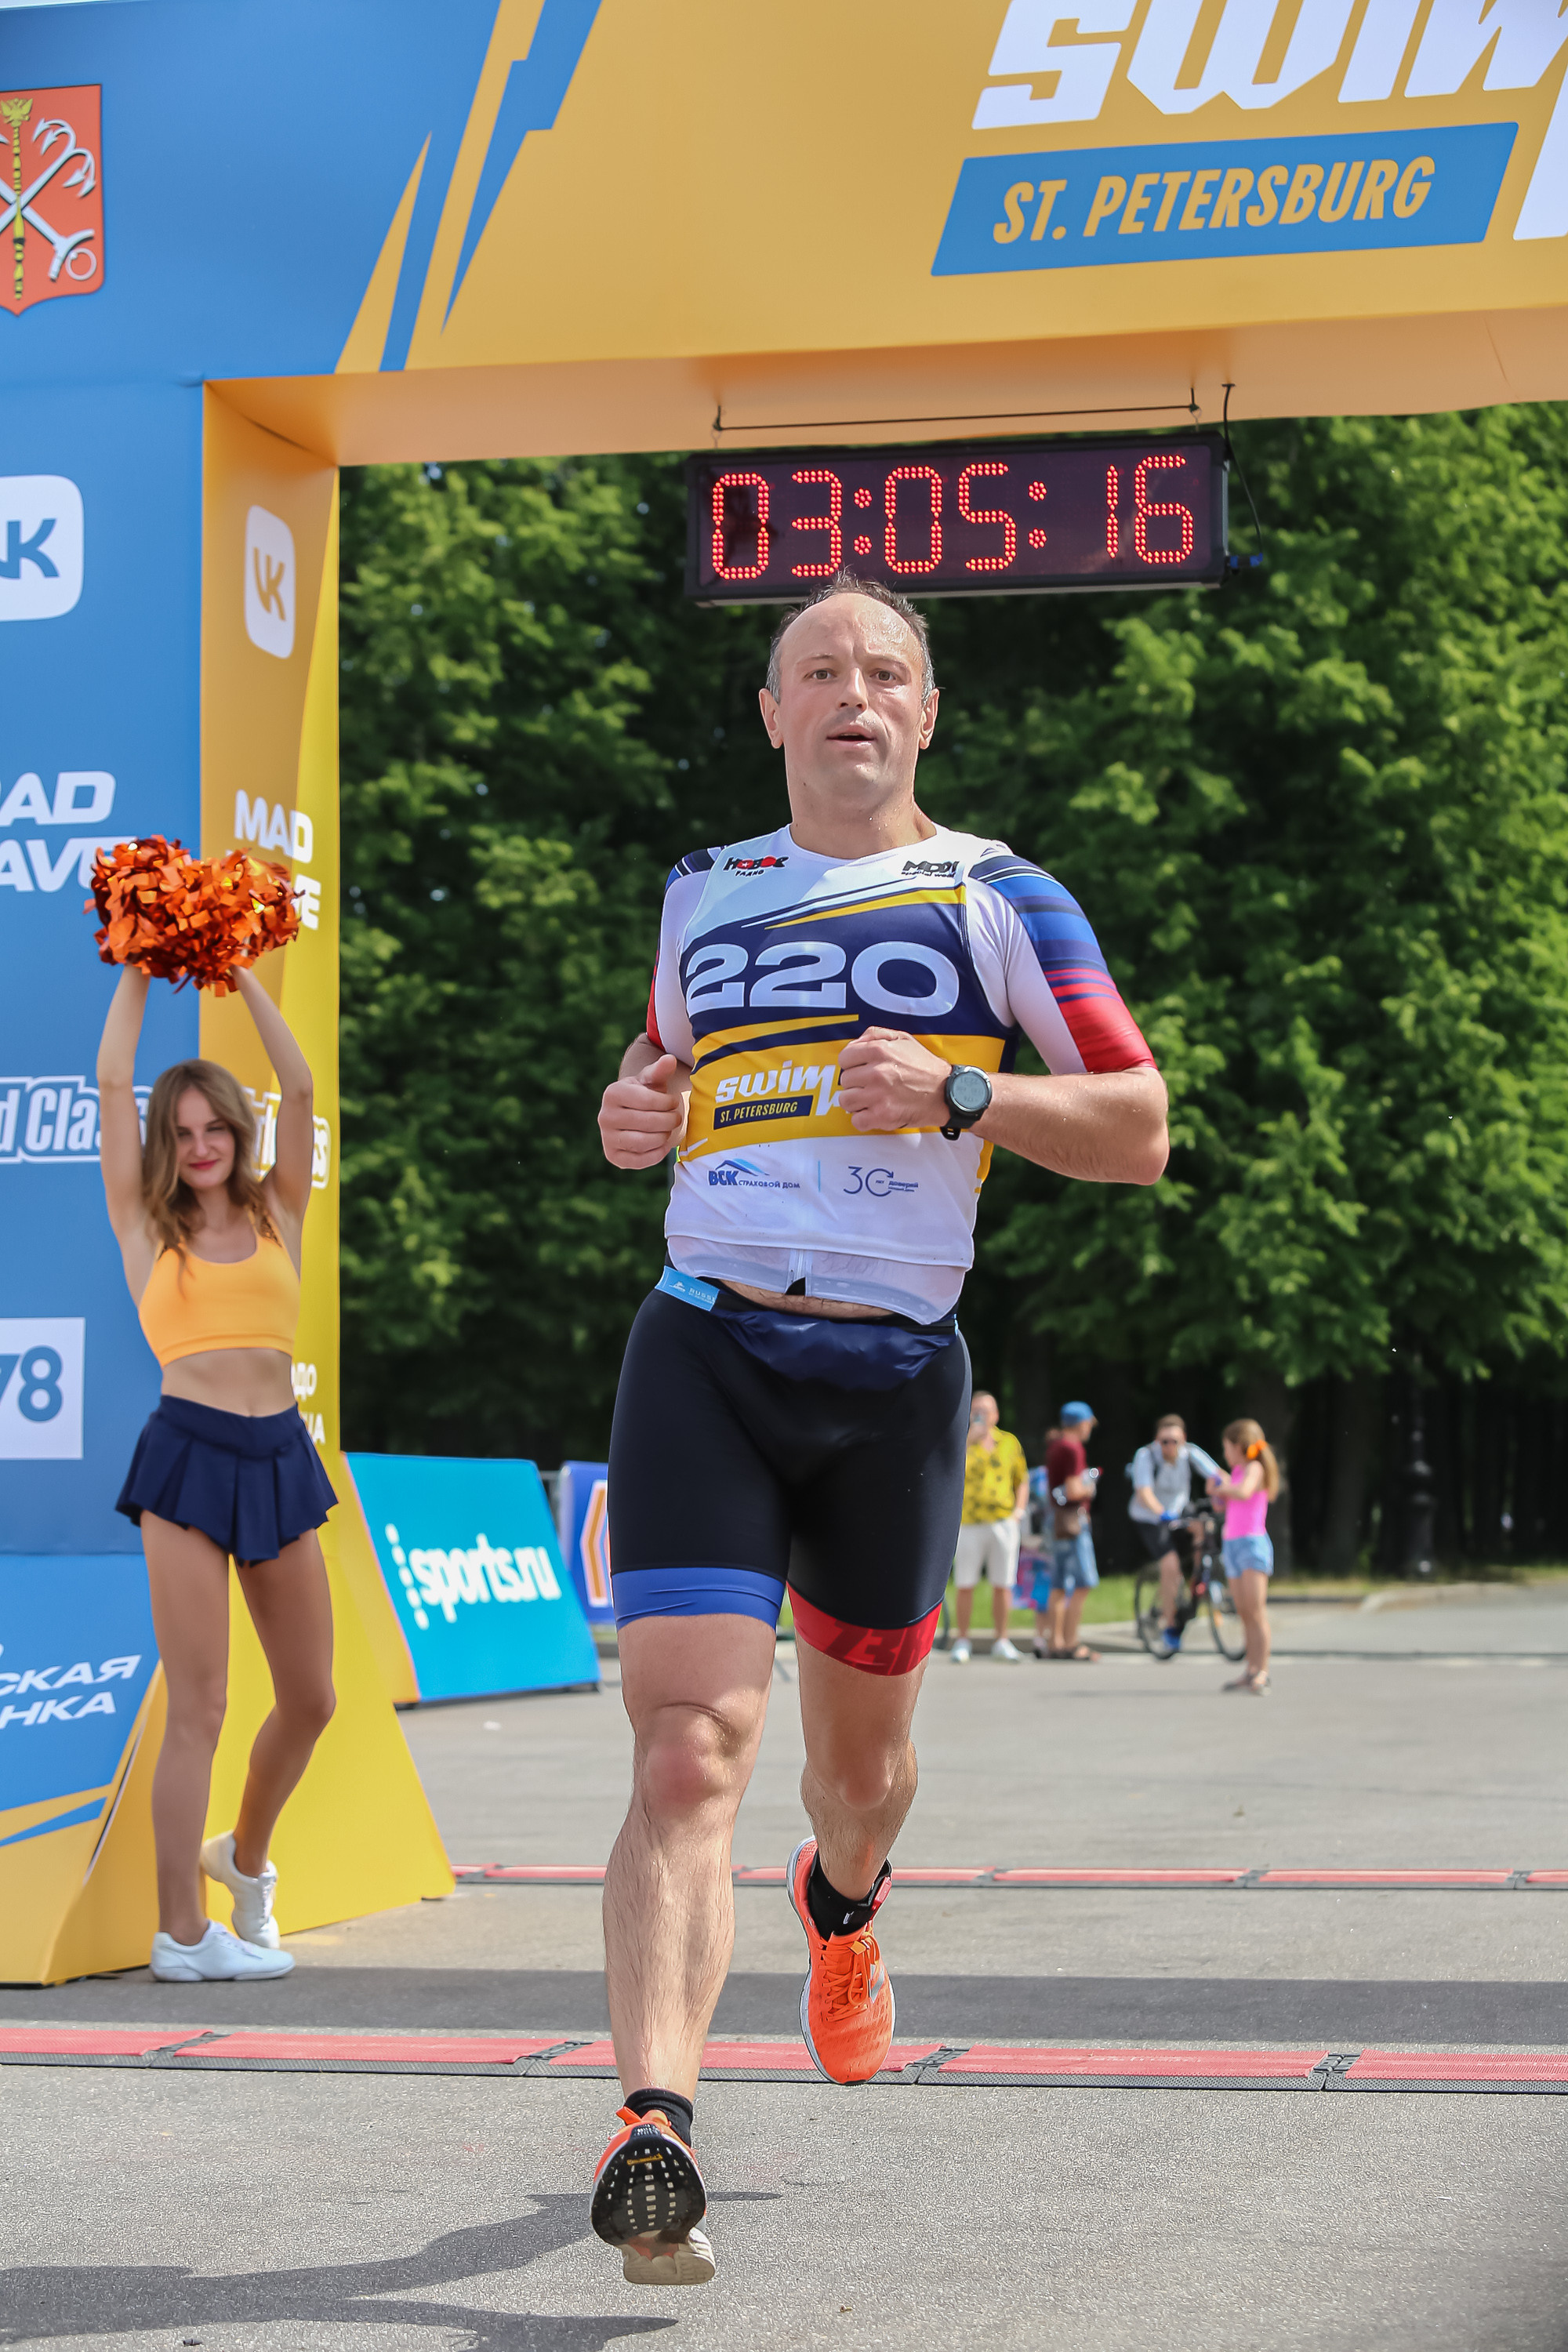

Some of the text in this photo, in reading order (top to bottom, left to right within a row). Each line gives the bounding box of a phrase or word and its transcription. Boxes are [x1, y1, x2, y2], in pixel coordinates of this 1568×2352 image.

[993, 156, 1436, 244] ST. PETERSBURG
[712, 455, 1194, 579] 03:05:16
[0, 771, 116, 827] AD
[234, 789, 314, 863] MAD
[686, 940, 960, 1018] 220
[720, 1102, 798, 1123] ST. PETERSBURG
[709, 1171, 739, 1185] ВСК
